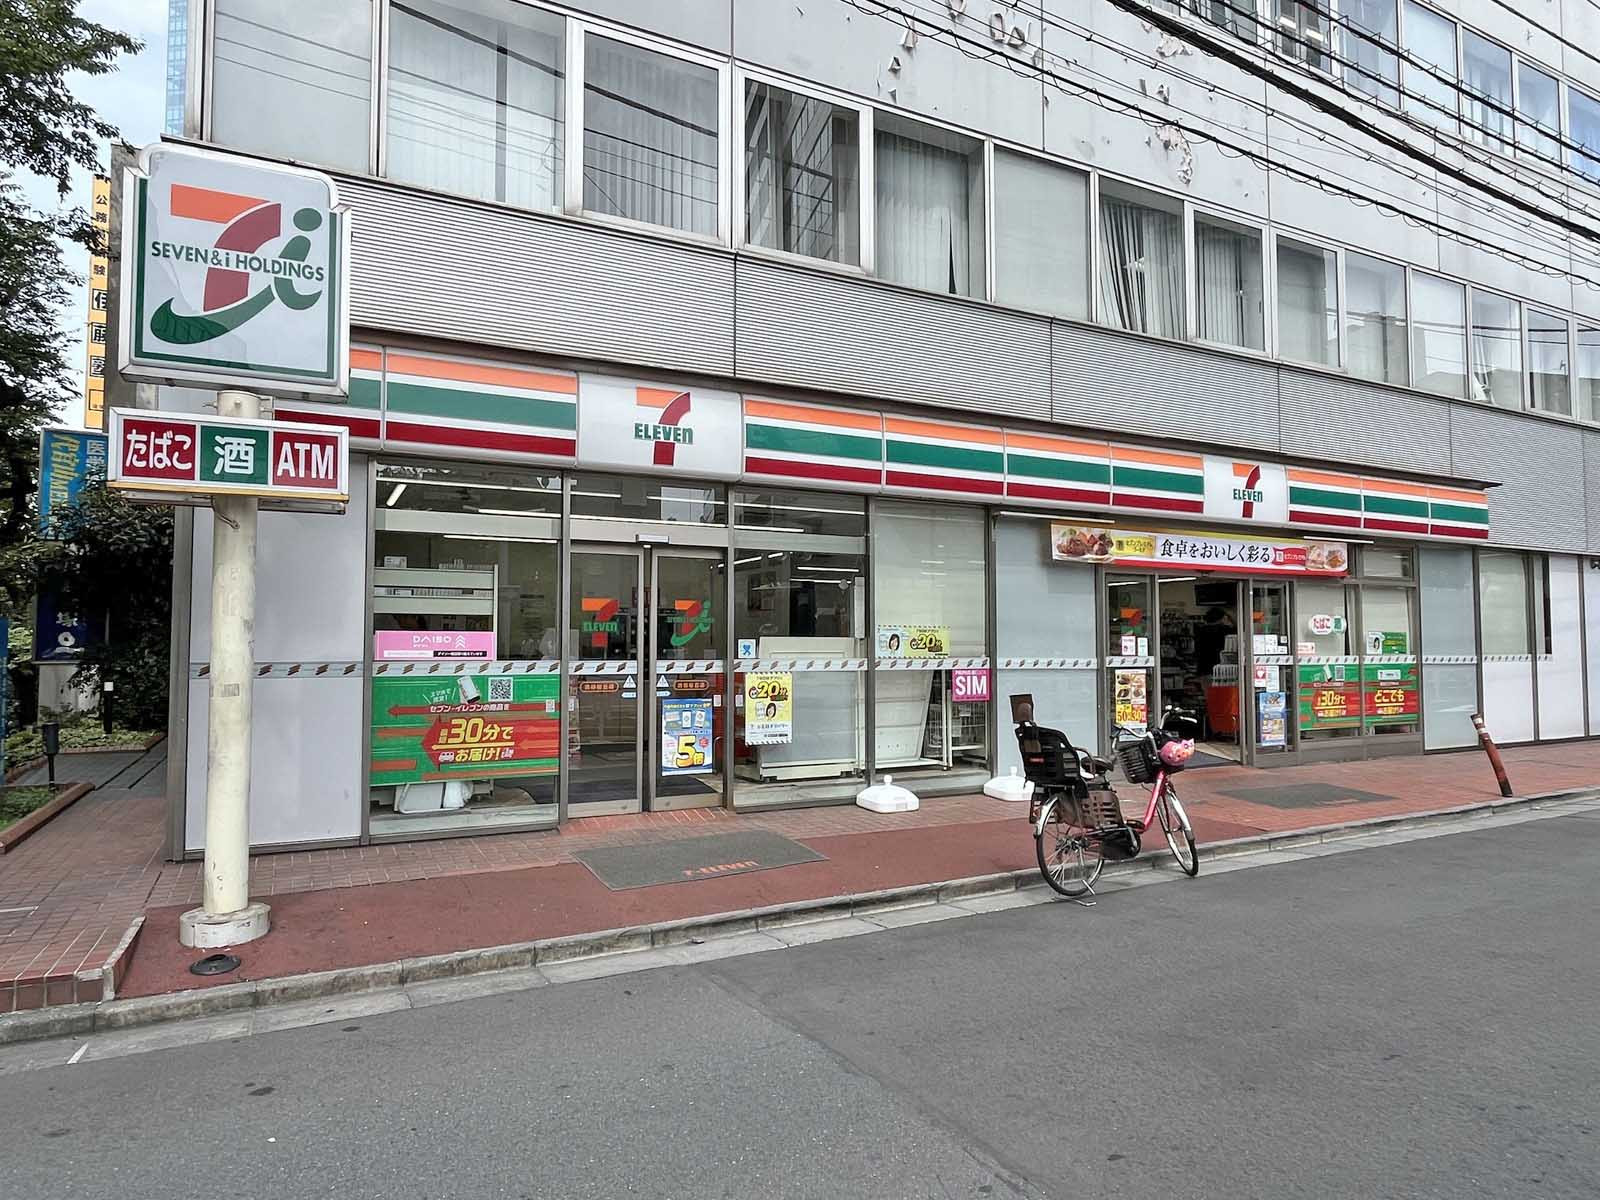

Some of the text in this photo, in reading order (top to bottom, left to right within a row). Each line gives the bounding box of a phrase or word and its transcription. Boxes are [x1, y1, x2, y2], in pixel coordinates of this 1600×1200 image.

[236, 254, 324, 281] HOLDINGS
[126, 429, 192, 470] たばこ
[214, 435, 256, 474] 酒
[277, 441, 334, 480] ATM
[1161, 538, 1270, 563] 食卓をおいしく彩る
[955, 675, 987, 696] SIM
[1374, 689, 1405, 703] どこでも
